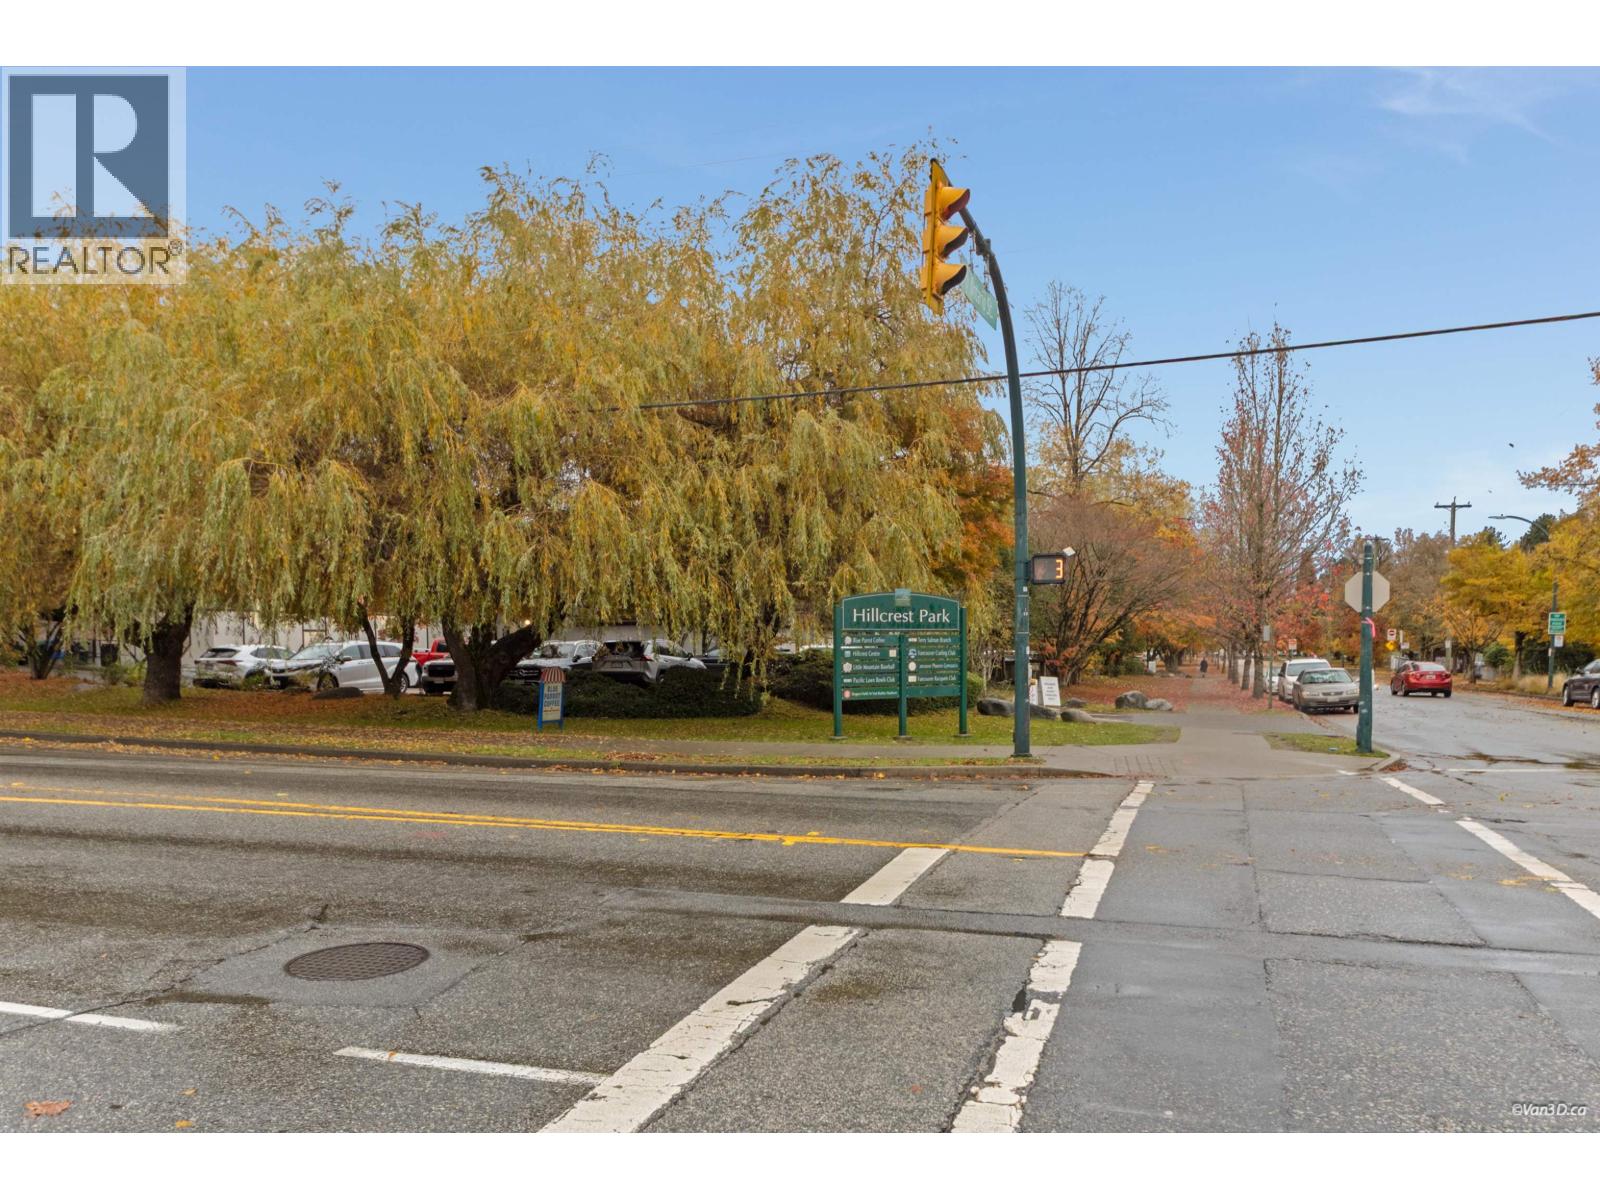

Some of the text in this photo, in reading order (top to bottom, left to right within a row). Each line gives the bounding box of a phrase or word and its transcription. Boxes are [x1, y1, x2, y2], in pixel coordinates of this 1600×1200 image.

[1055, 559, 1063, 579] 3
[853, 608, 950, 623] Hillcrest Park
